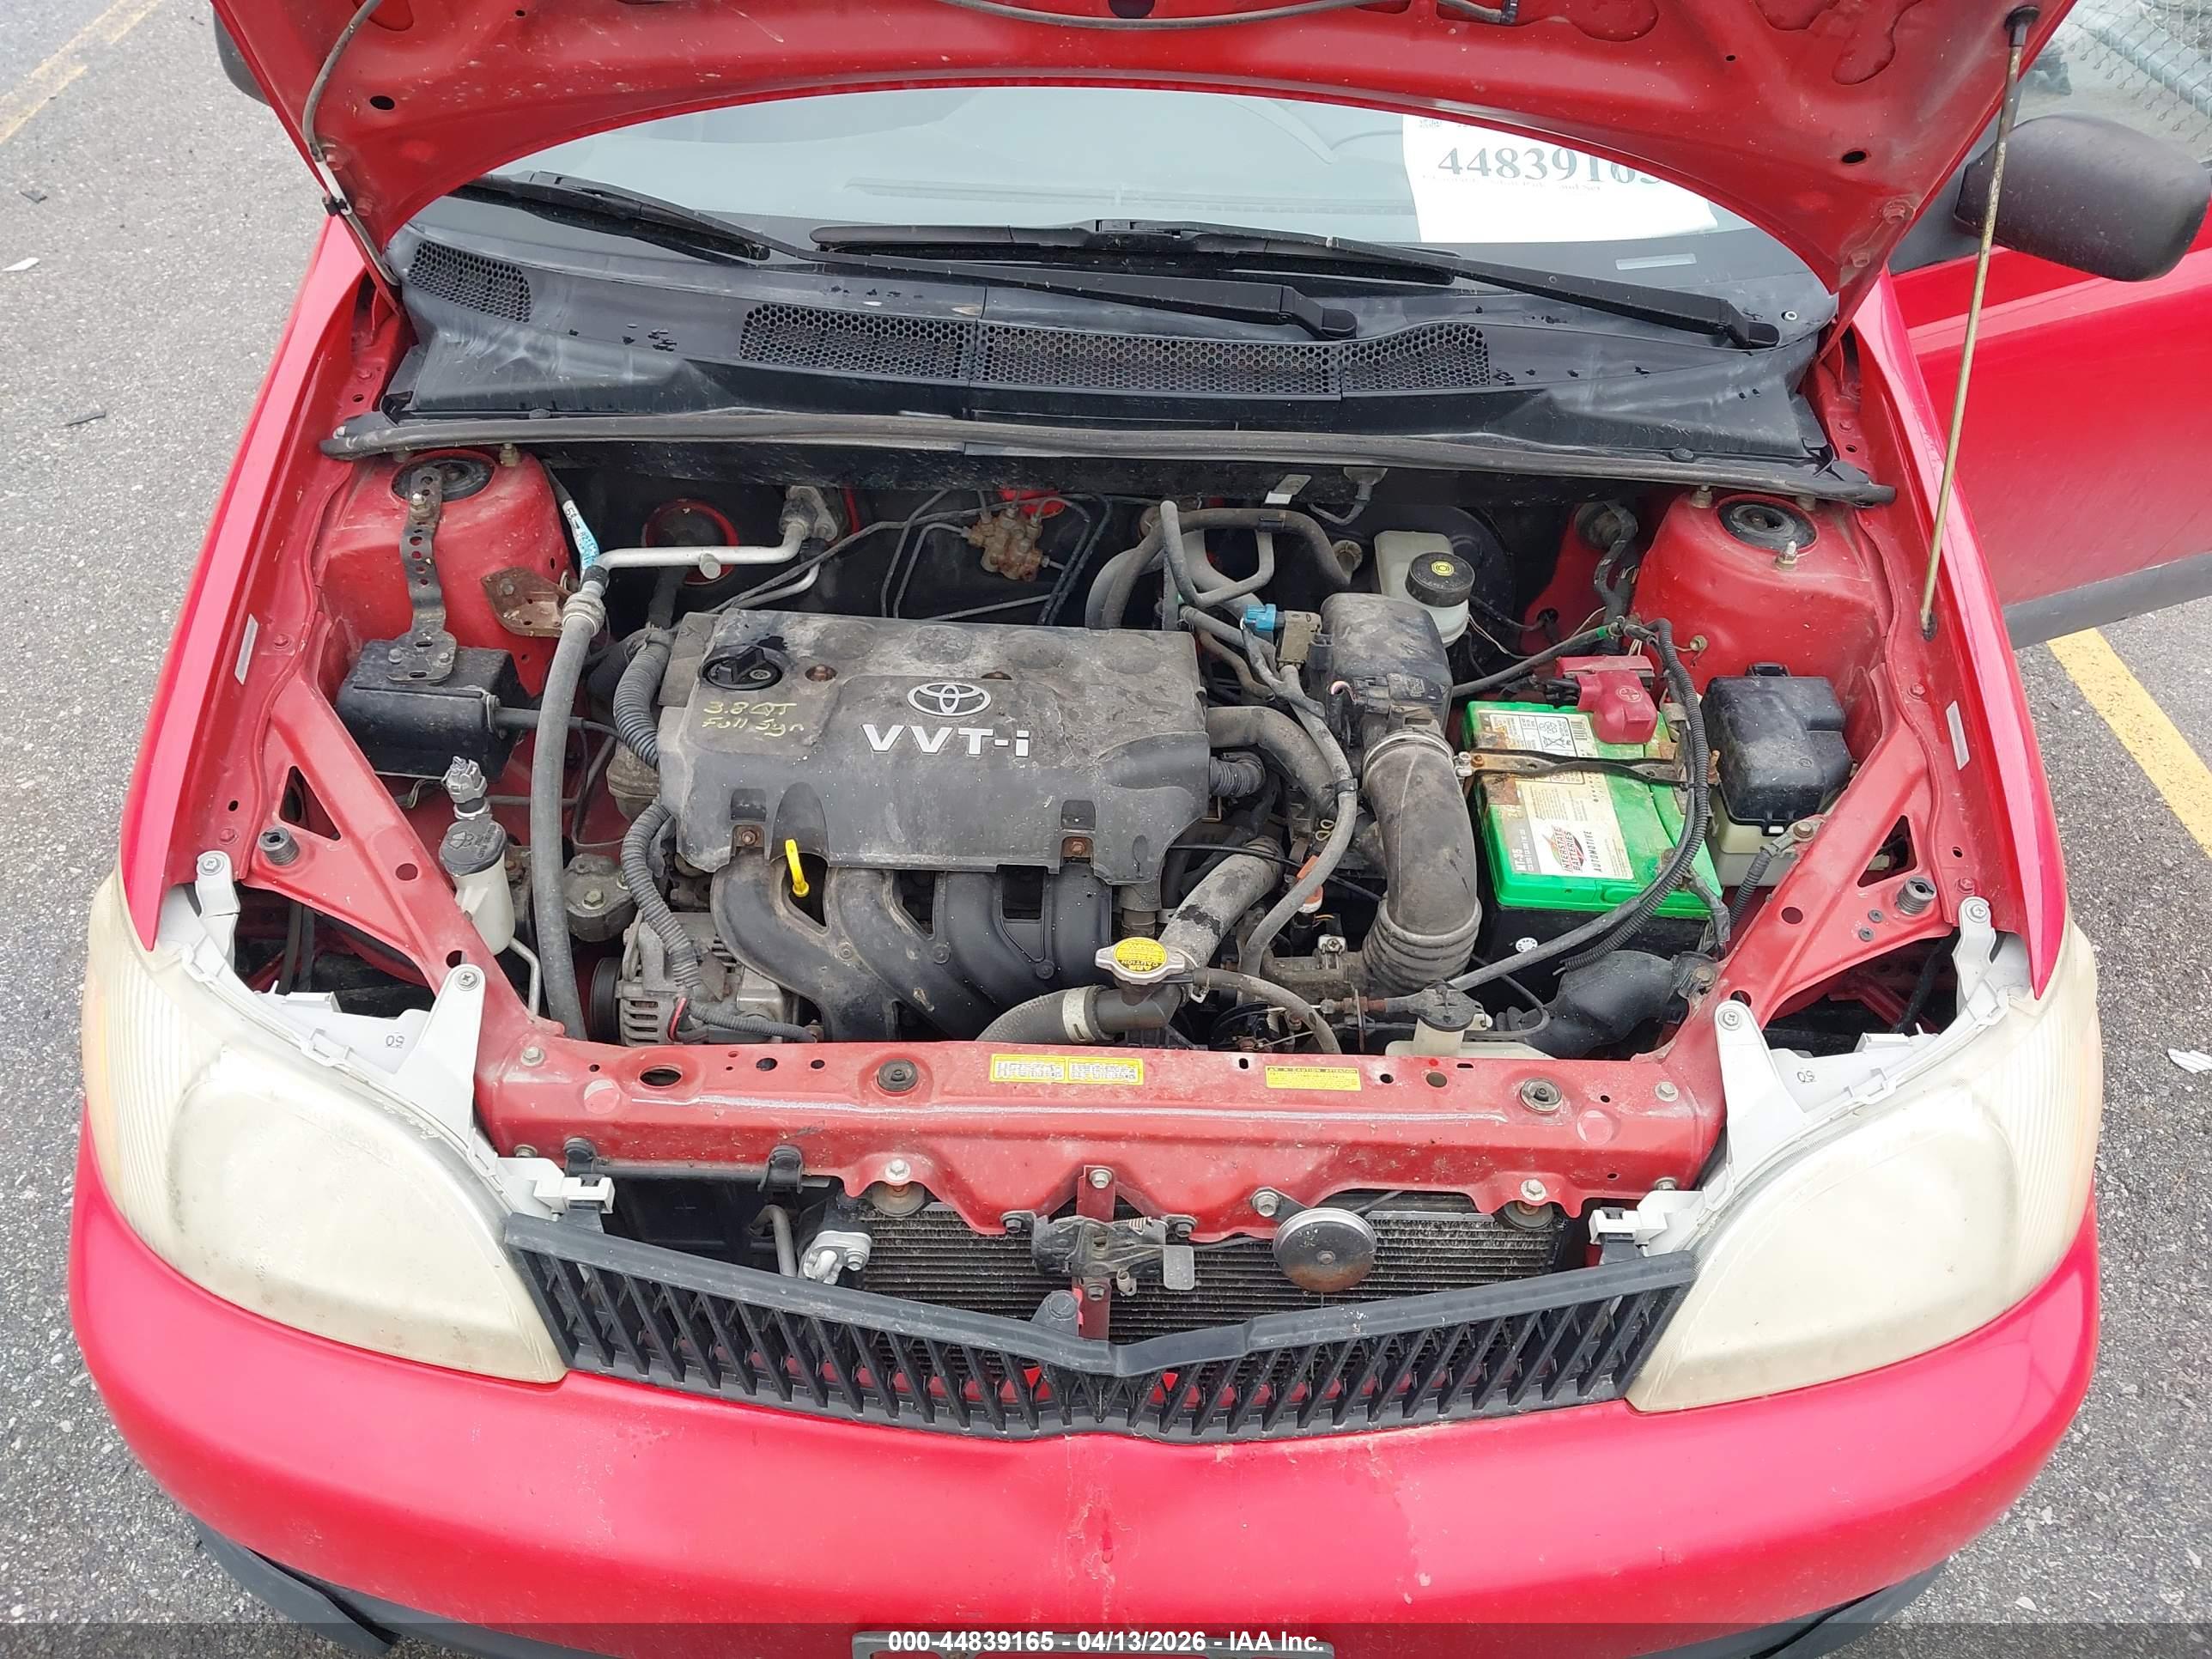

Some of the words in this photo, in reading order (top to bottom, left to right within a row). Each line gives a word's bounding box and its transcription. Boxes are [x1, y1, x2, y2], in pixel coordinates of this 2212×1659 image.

[861, 723, 1030, 757] VVT-i
[1553, 826, 1573, 873] INTERSTATE
[1564, 830, 1582, 872] BATTERIES
[1583, 830, 1602, 872] AUTOMOTIVE
